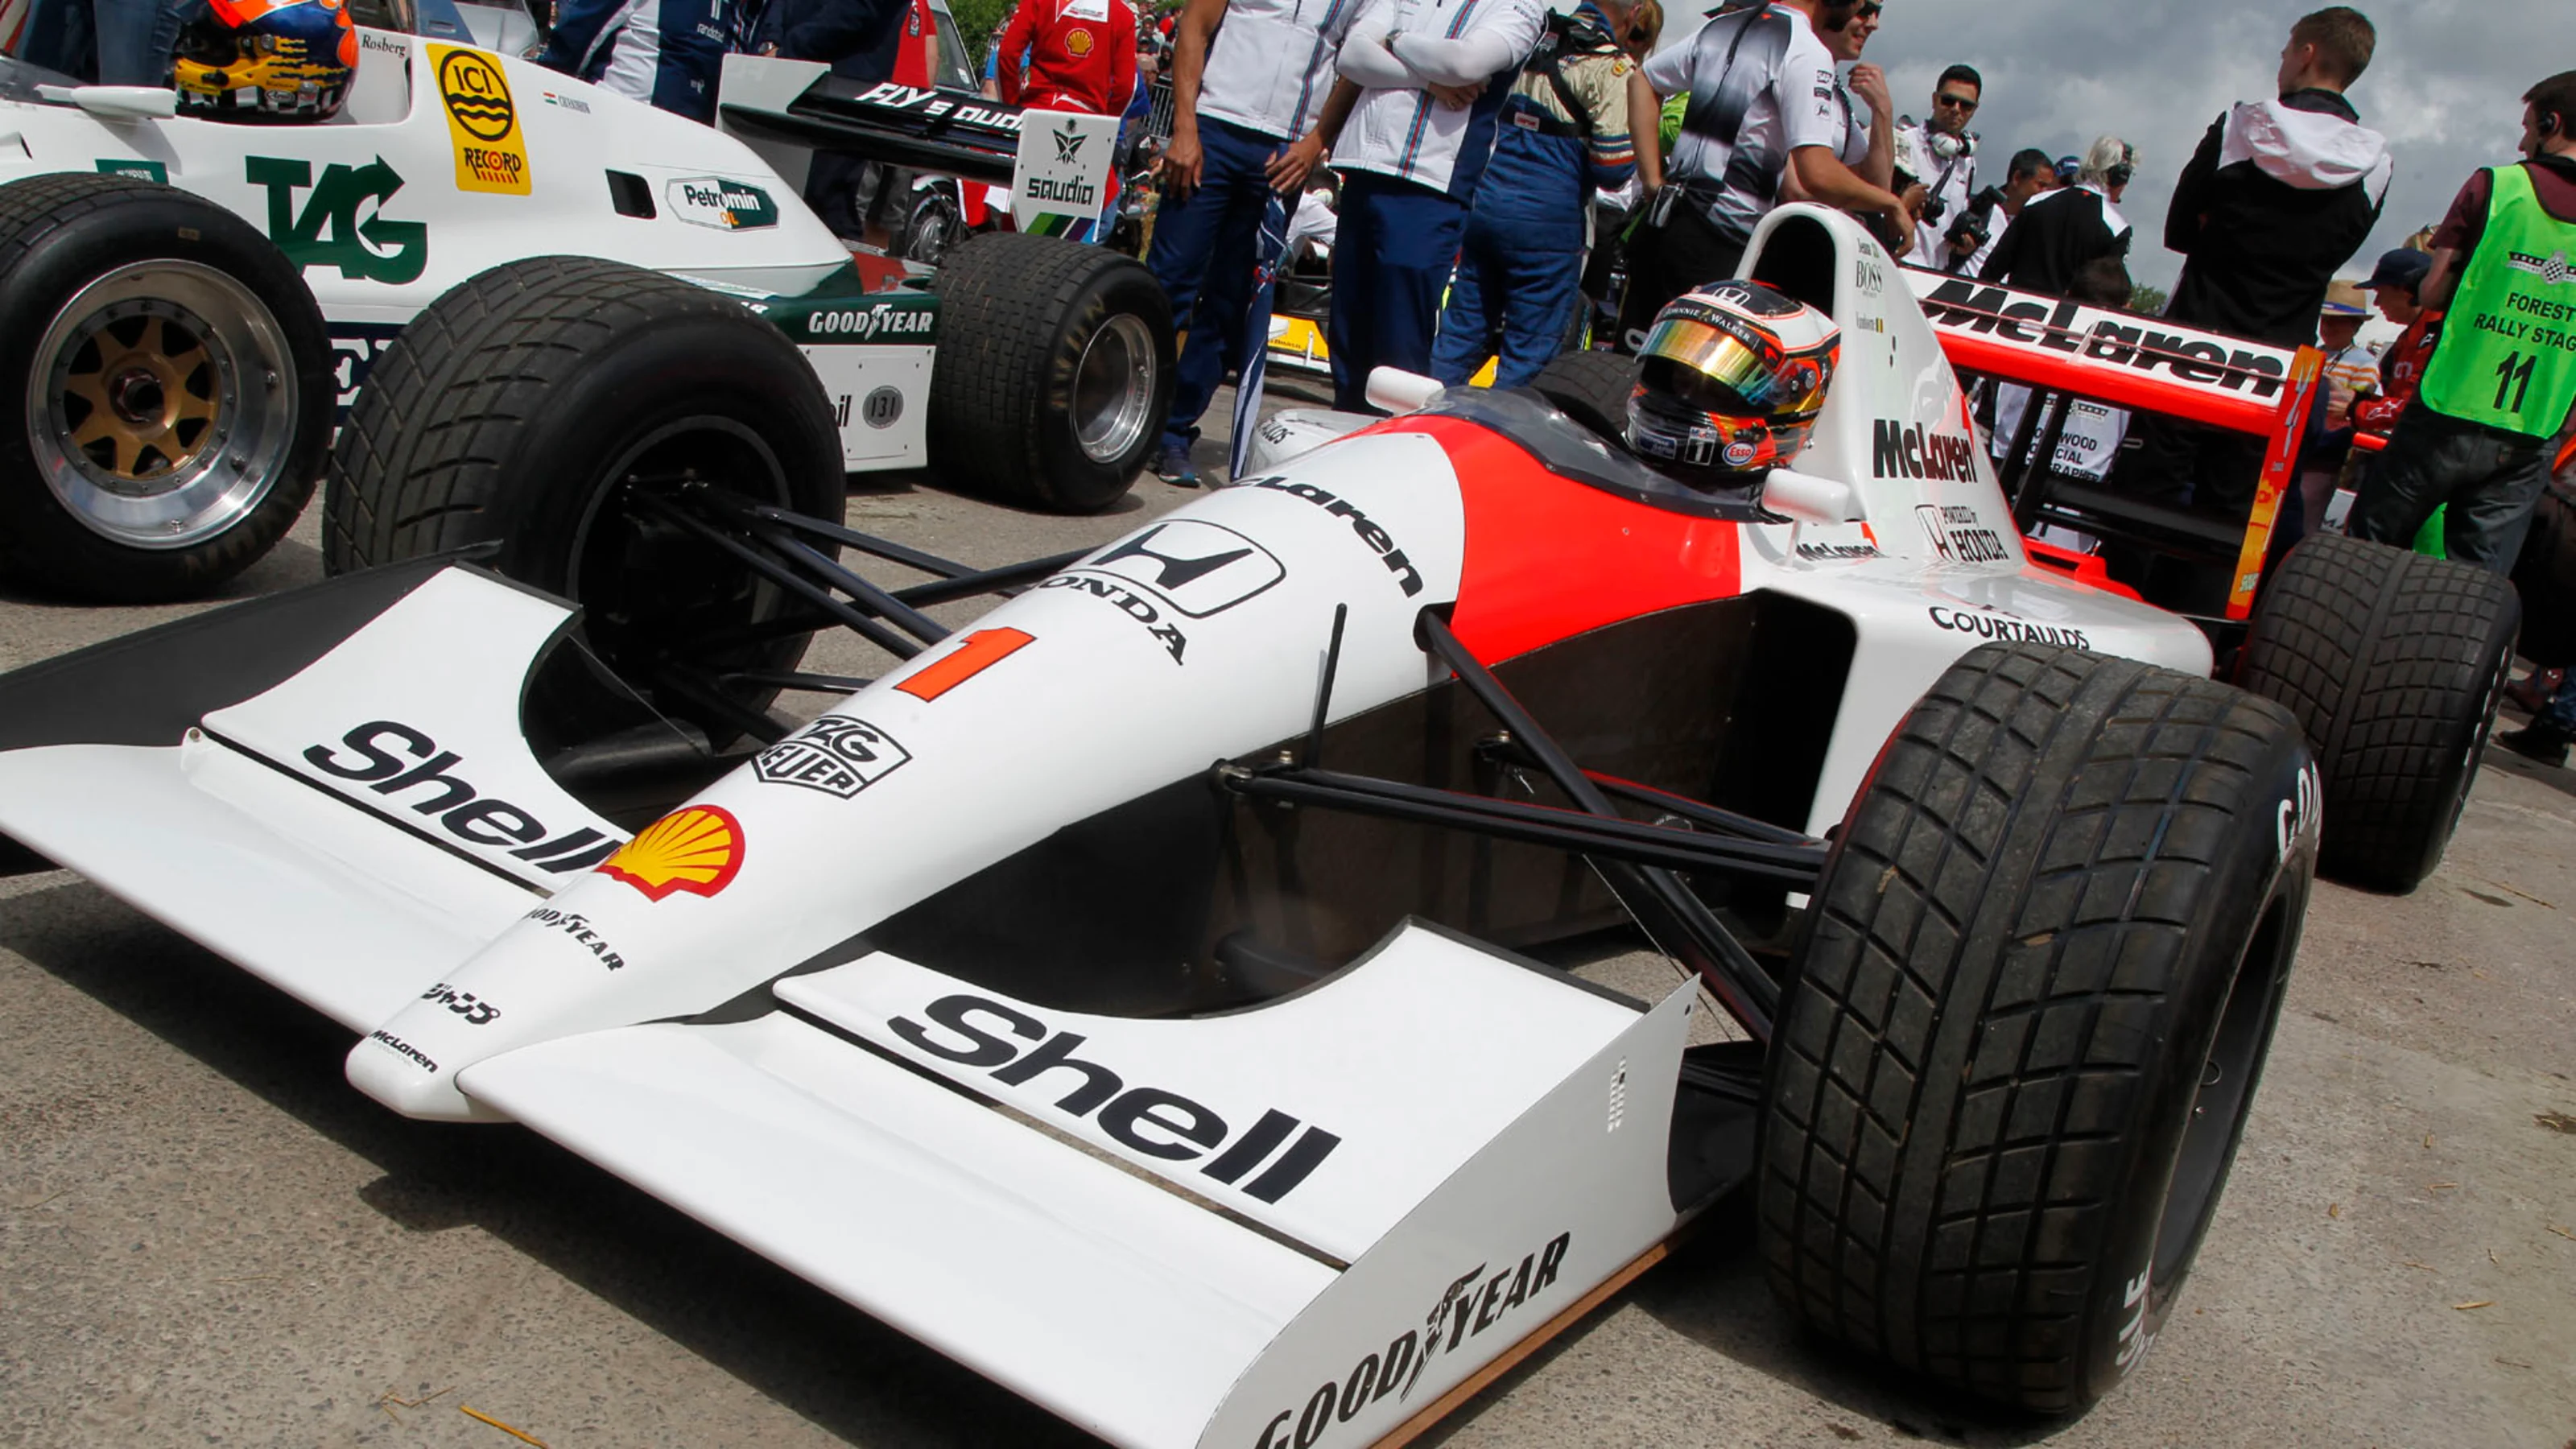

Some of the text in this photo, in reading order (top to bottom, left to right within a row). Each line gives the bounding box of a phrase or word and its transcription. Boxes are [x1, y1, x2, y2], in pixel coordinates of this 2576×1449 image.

[362, 34, 406, 57] Rosberg
[453, 65, 493, 94] ICI
[855, 82, 938, 107] FLY
[464, 147, 522, 183] RECORD
[683, 184, 761, 210] Petromin
[1026, 175, 1094, 205] saudia
[245, 154, 427, 284] TAG
[1856, 260, 1882, 293] BOSS
[2506, 292, 2576, 322] FOREST
[1711, 313, 1750, 341] WALKER
[1925, 279, 2285, 398] McLaren
[2474, 313, 2576, 352] RALLY STAG
[2494, 350, 2537, 414] 11
[870, 396, 897, 418] 131
[1729, 446, 1752, 457] Esso
[1873, 419, 1978, 483] McLaren
[1234, 477, 1423, 598] cLaren
[1950, 529, 2010, 562] HONDA
[1035, 576, 1187, 666] ONDA
[1929, 606, 2090, 651] COURTAULDS
[892, 626, 1038, 703] 1
[303, 720, 626, 873] Shell
[369, 1030, 439, 1073] McLaren
[886, 994, 1343, 1205] Shell
